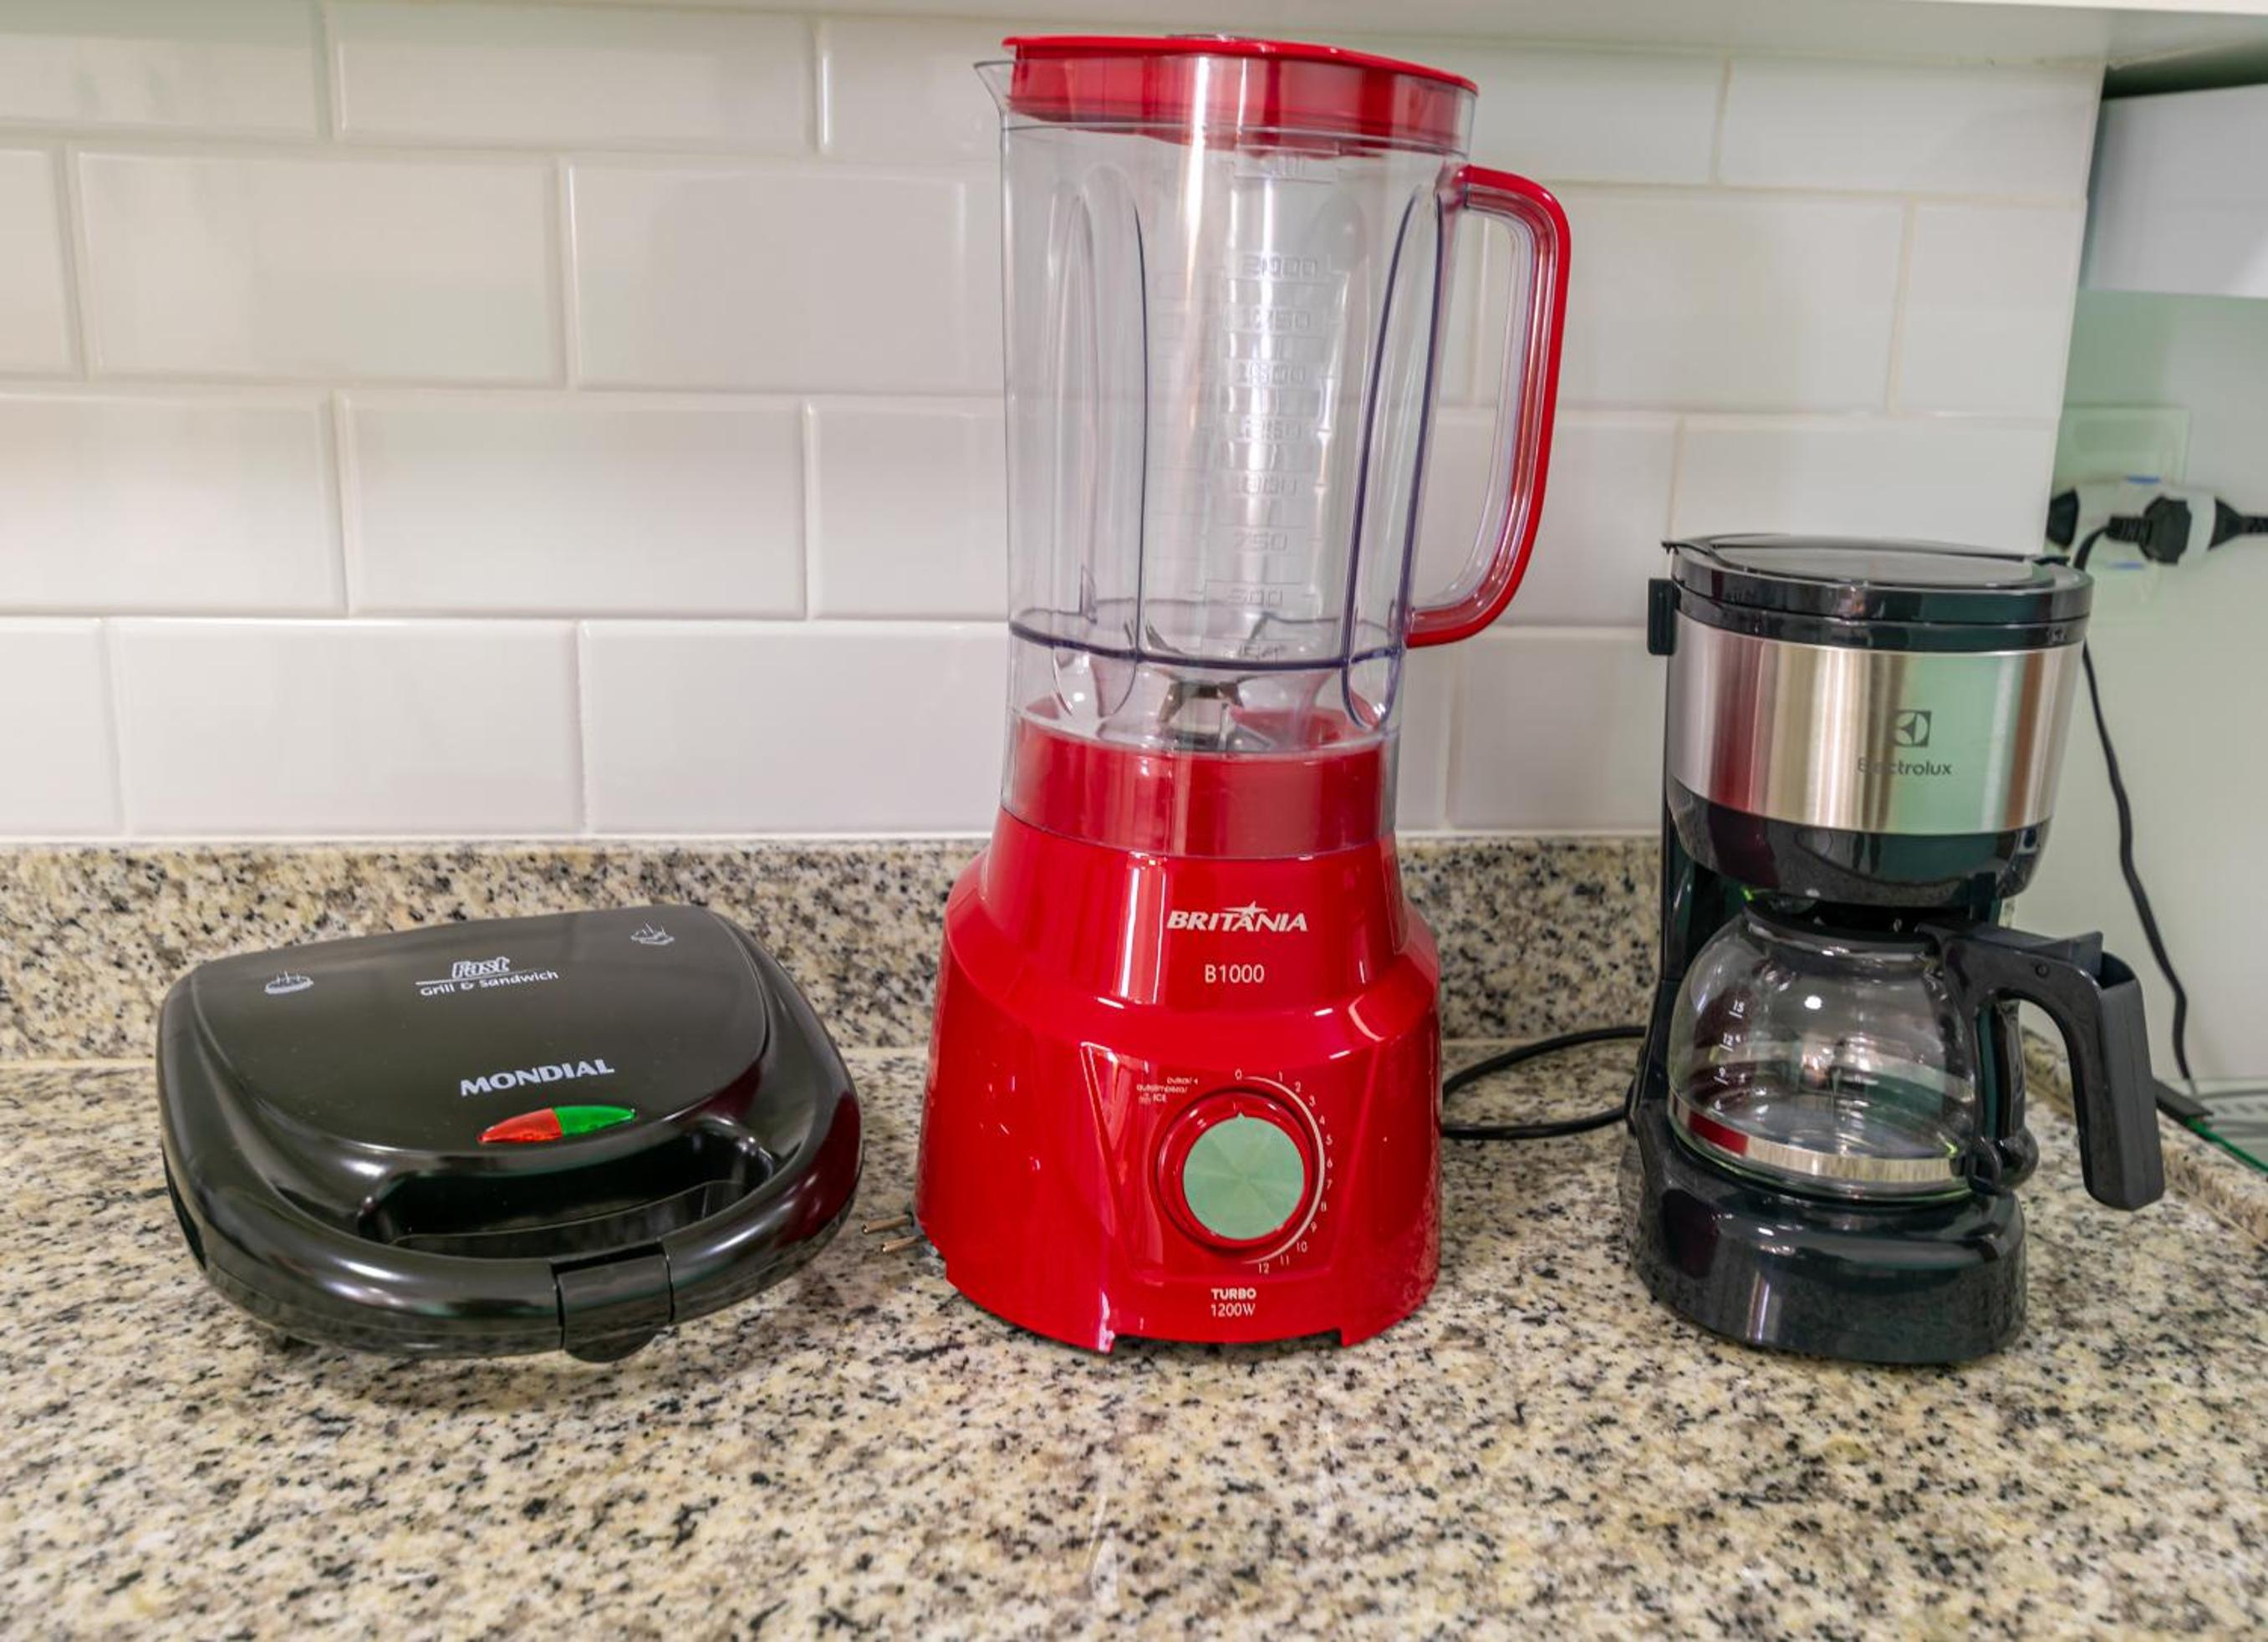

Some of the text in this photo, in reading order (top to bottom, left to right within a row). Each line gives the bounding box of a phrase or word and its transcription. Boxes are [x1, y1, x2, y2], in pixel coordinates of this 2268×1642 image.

[1857, 757, 1954, 776] Ectrolux
[451, 956, 511, 979] Fast
[1204, 963, 1265, 984] B1000
[420, 982, 456, 997] Grill
[460, 1058, 615, 1097] MONDIAL
[1295, 1081, 1302, 1093] 2
[1297, 1241, 1307, 1253] 10
[1258, 1262, 1270, 1274] 12
[1280, 1255, 1290, 1266] 11
[1210, 1288, 1256, 1300] TURBO
[1210, 1303, 1256, 1318] 1200W
